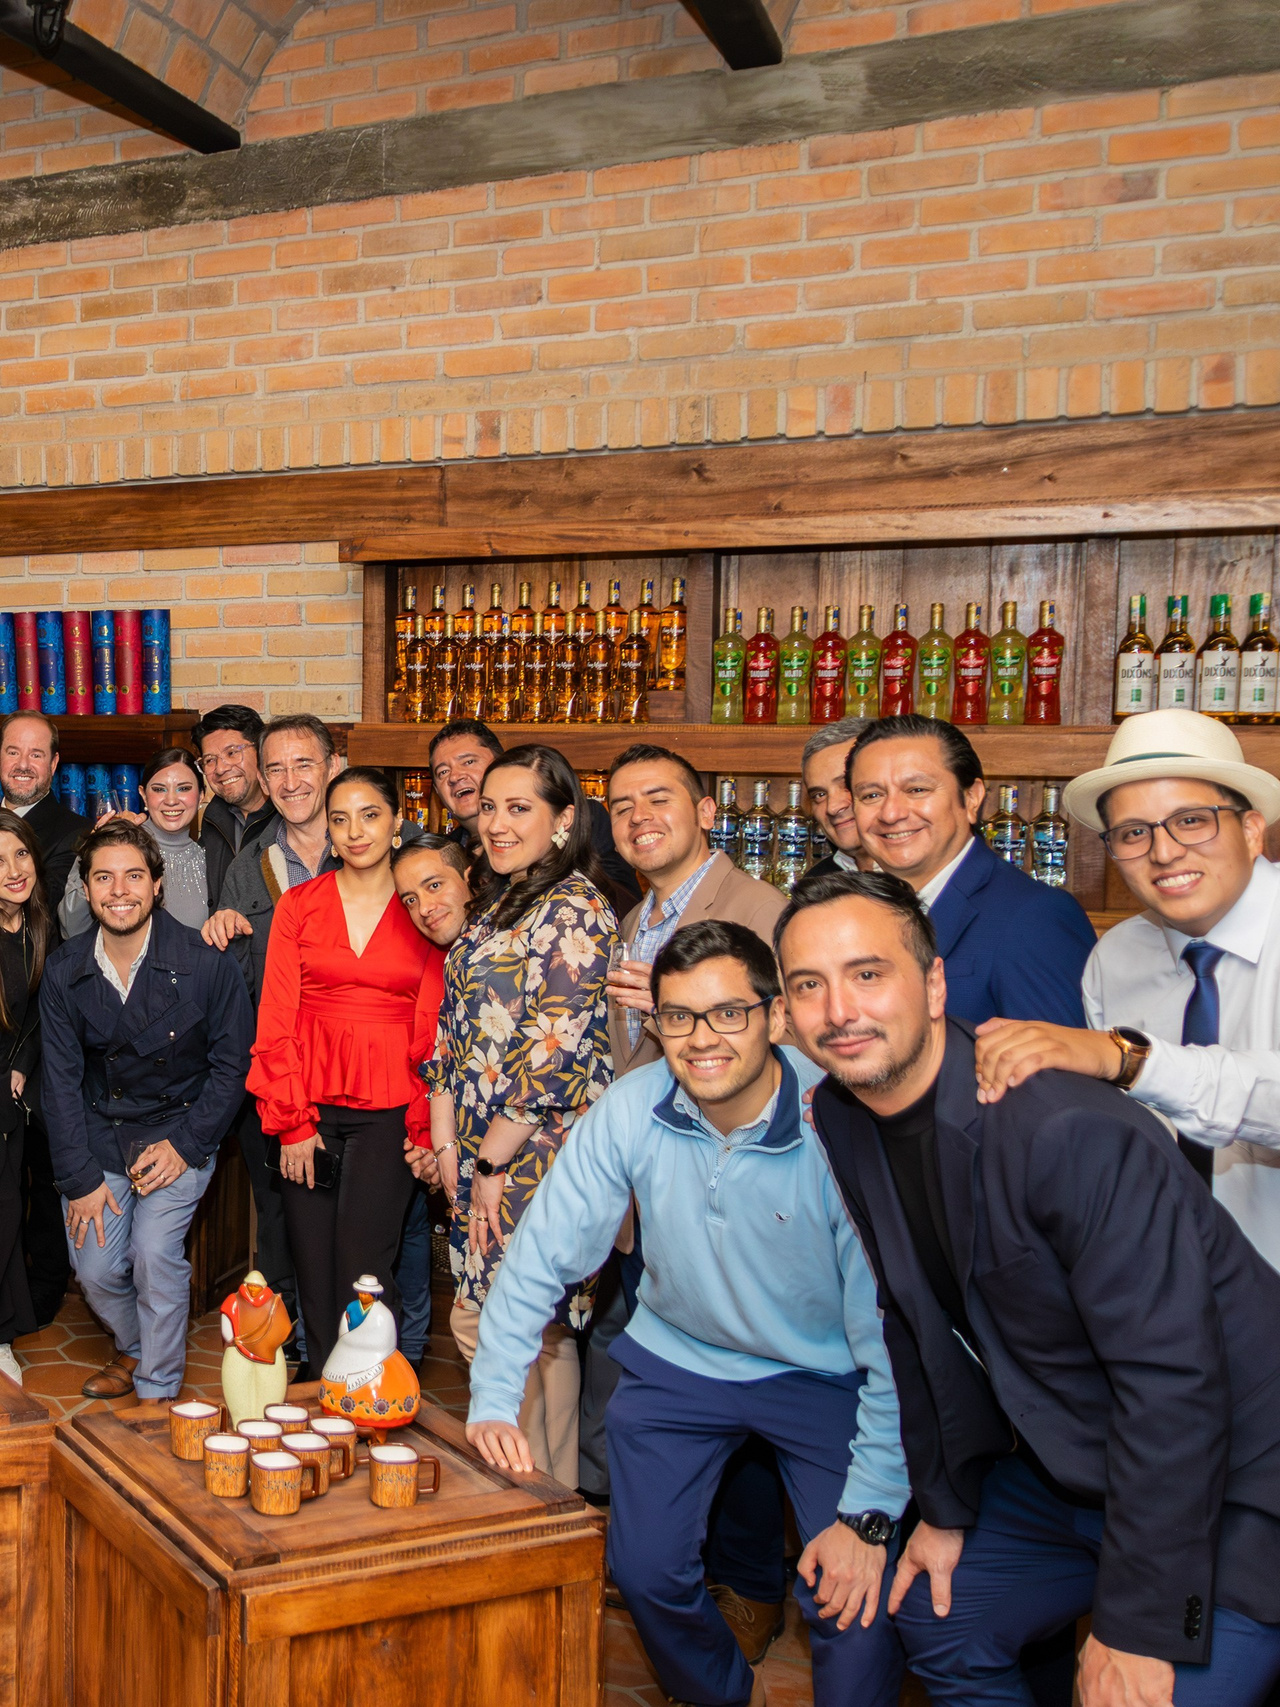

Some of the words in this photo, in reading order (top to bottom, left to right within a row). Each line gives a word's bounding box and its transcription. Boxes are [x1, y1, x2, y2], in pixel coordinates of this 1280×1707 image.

[718, 670, 736, 678] MOJITO
[784, 669, 803, 678] MOJITO
[854, 669, 873, 677] MOJITO
[923, 668, 942, 677] MOJITO
[998, 668, 1018, 676] MOJITO
[1121, 668, 1152, 679] DIXONS
[1163, 668, 1194, 679] DIXONS
[1204, 666, 1236, 677] DIXONS
[1244, 666, 1276, 678] DIXONS
